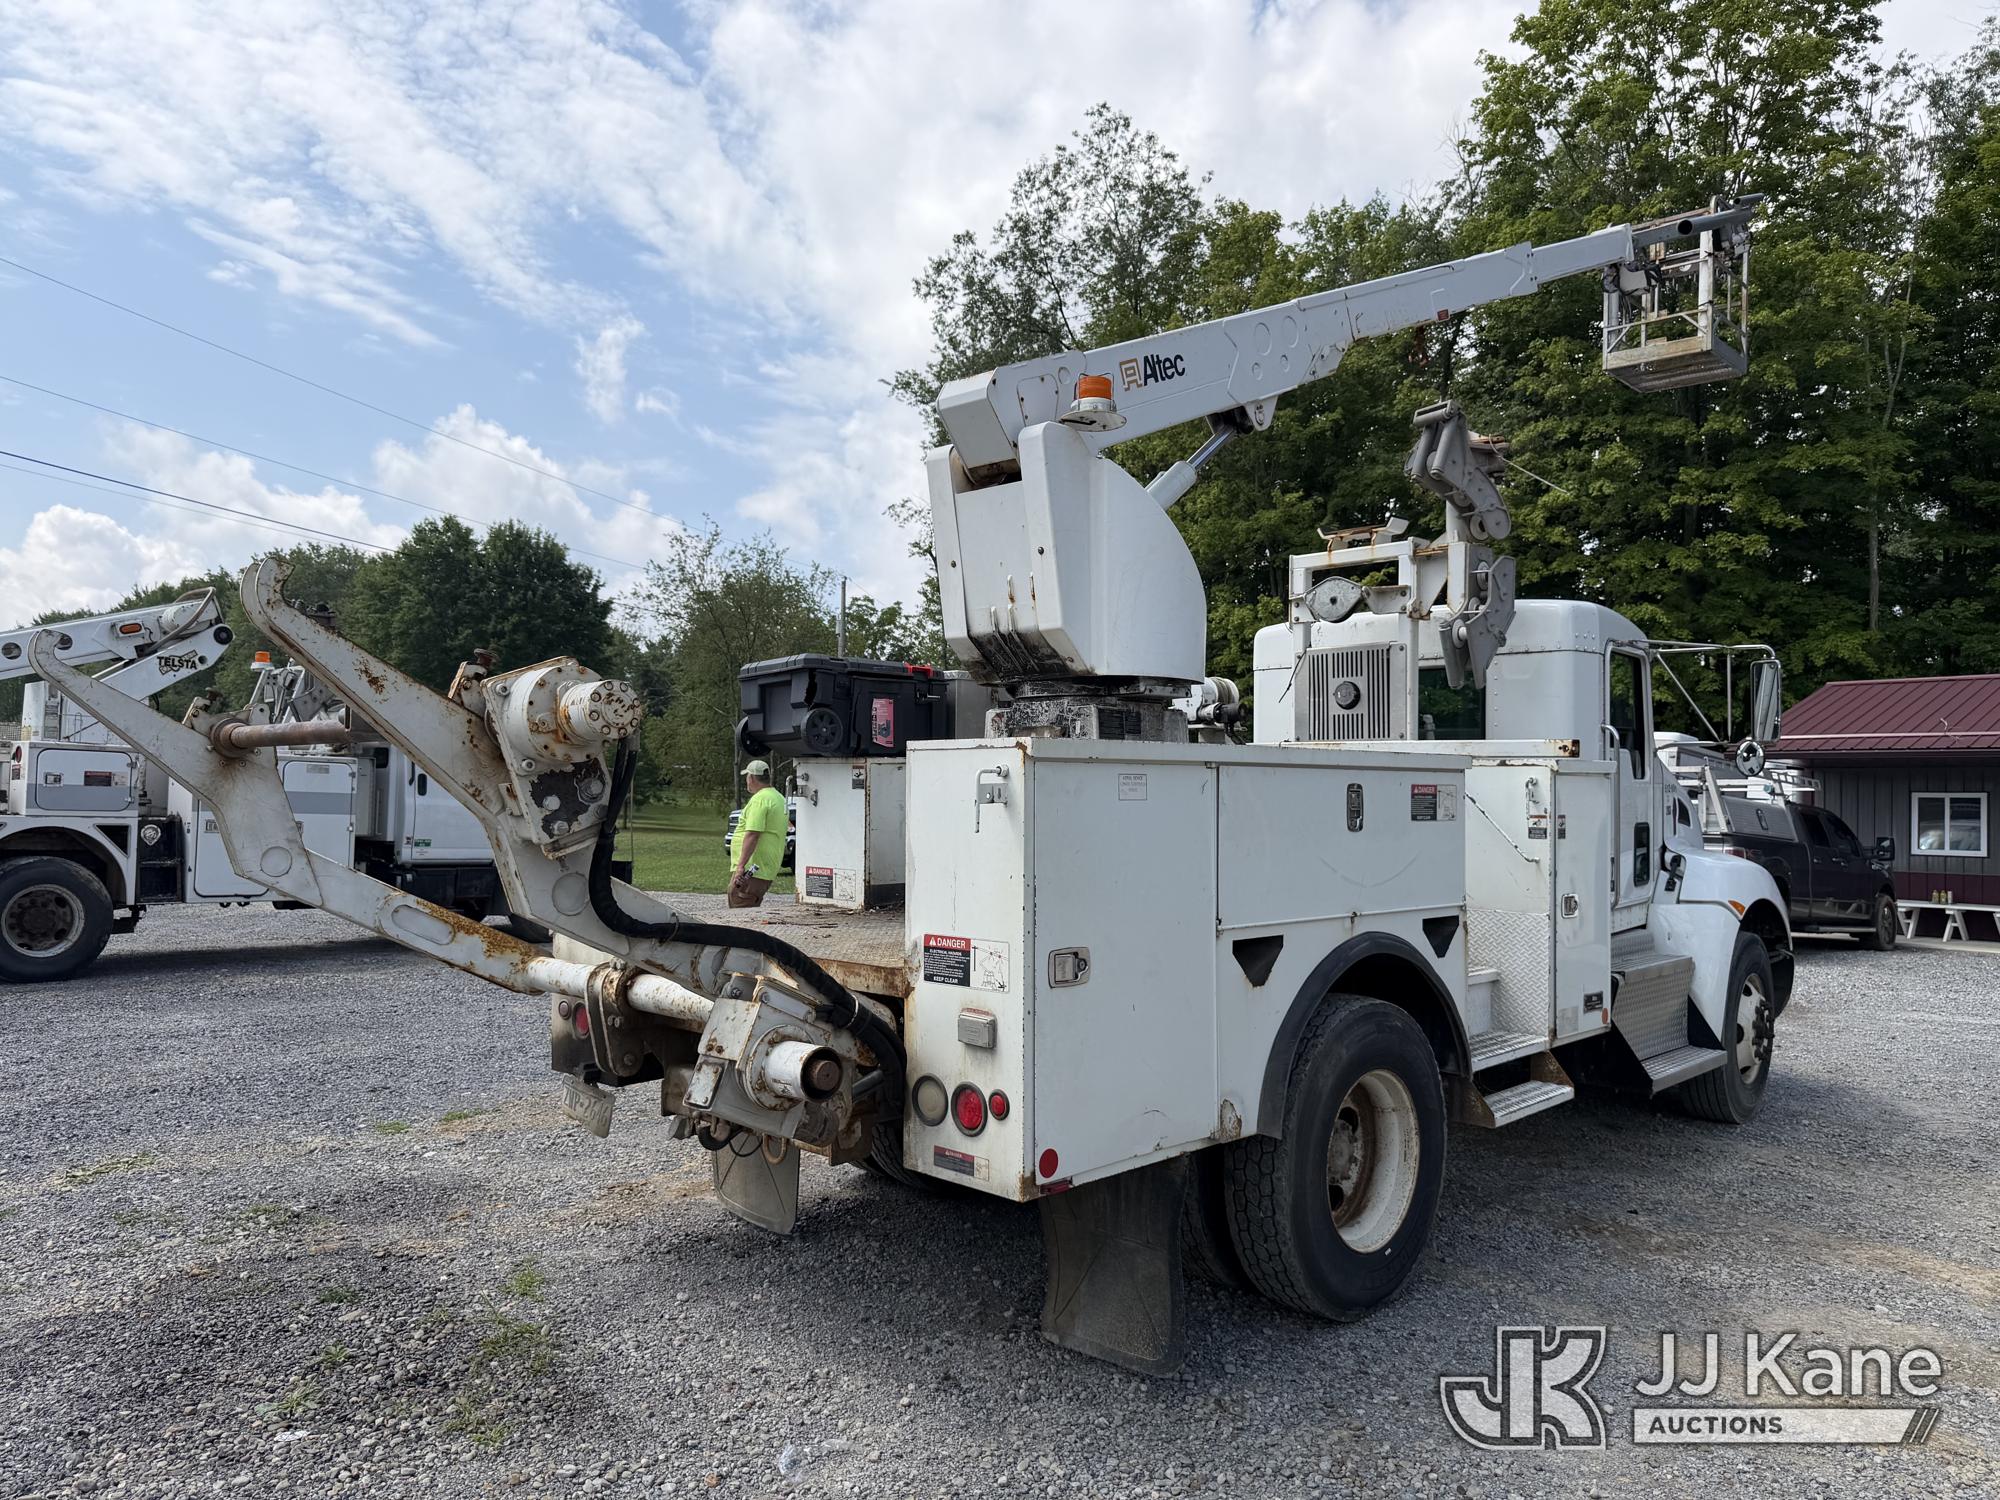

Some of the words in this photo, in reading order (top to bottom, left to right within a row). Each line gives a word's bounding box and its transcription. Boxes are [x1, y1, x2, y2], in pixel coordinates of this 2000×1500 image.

[1143, 354, 1185, 386] Altec
[156, 656, 197, 670] TELSTA
[937, 938, 966, 949] DANGER
